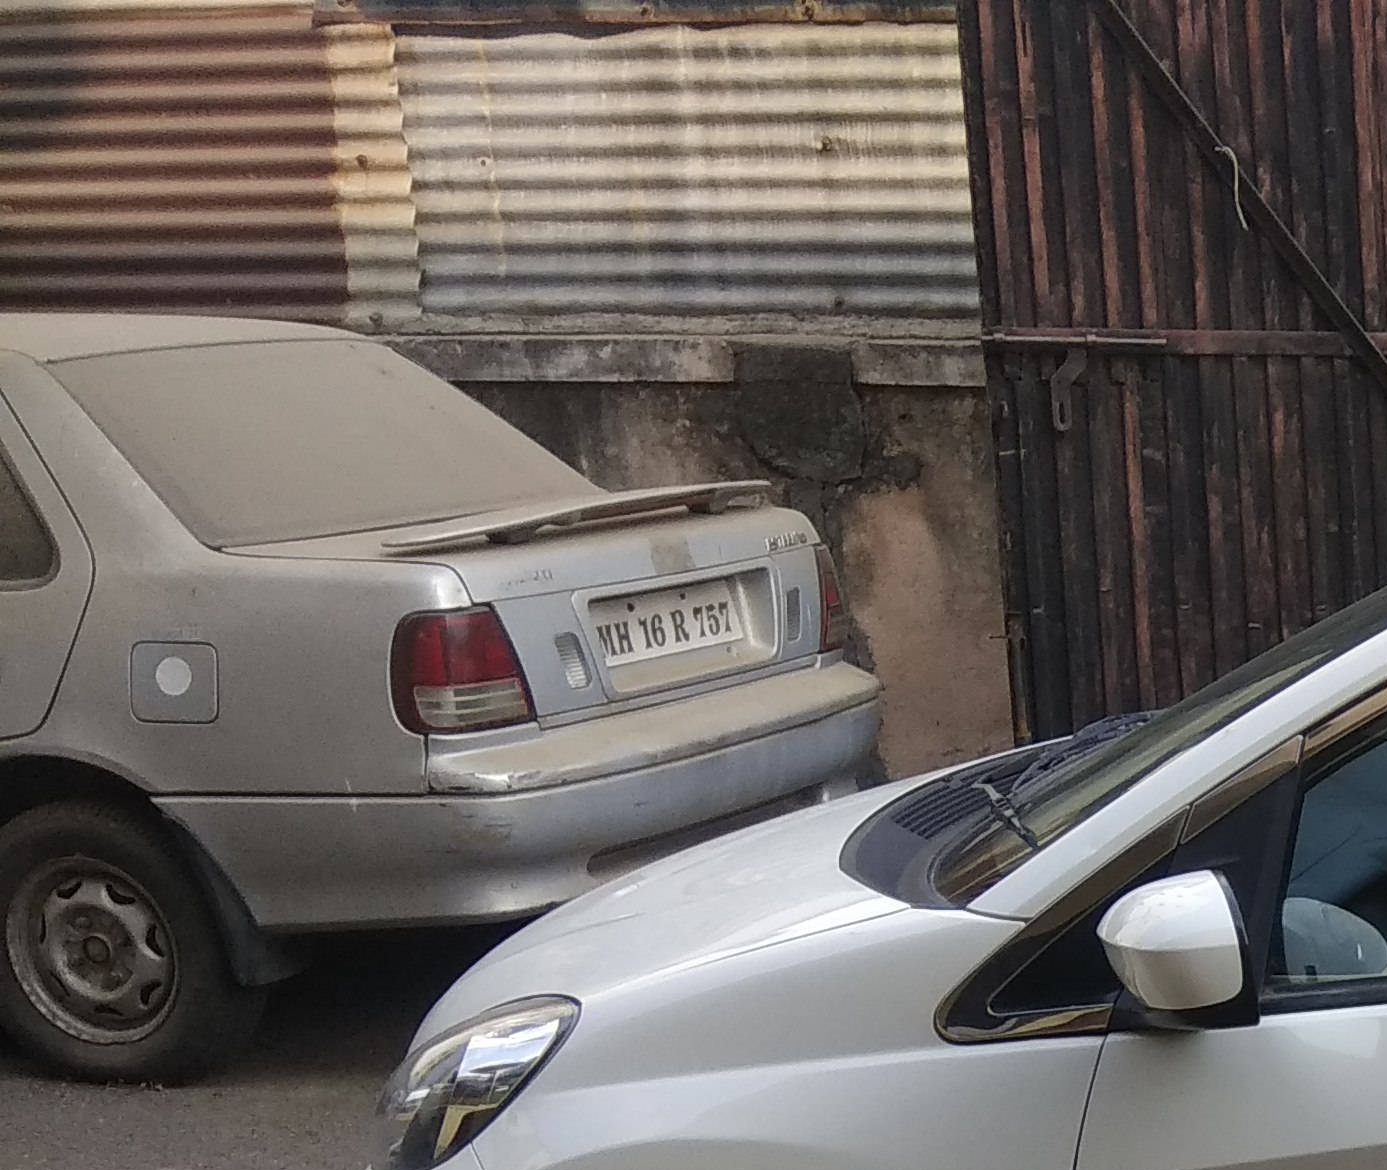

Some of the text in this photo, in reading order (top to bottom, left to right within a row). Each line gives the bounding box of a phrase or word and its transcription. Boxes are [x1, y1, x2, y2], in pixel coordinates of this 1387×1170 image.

[595, 601, 732, 657] MH 16 R 757
